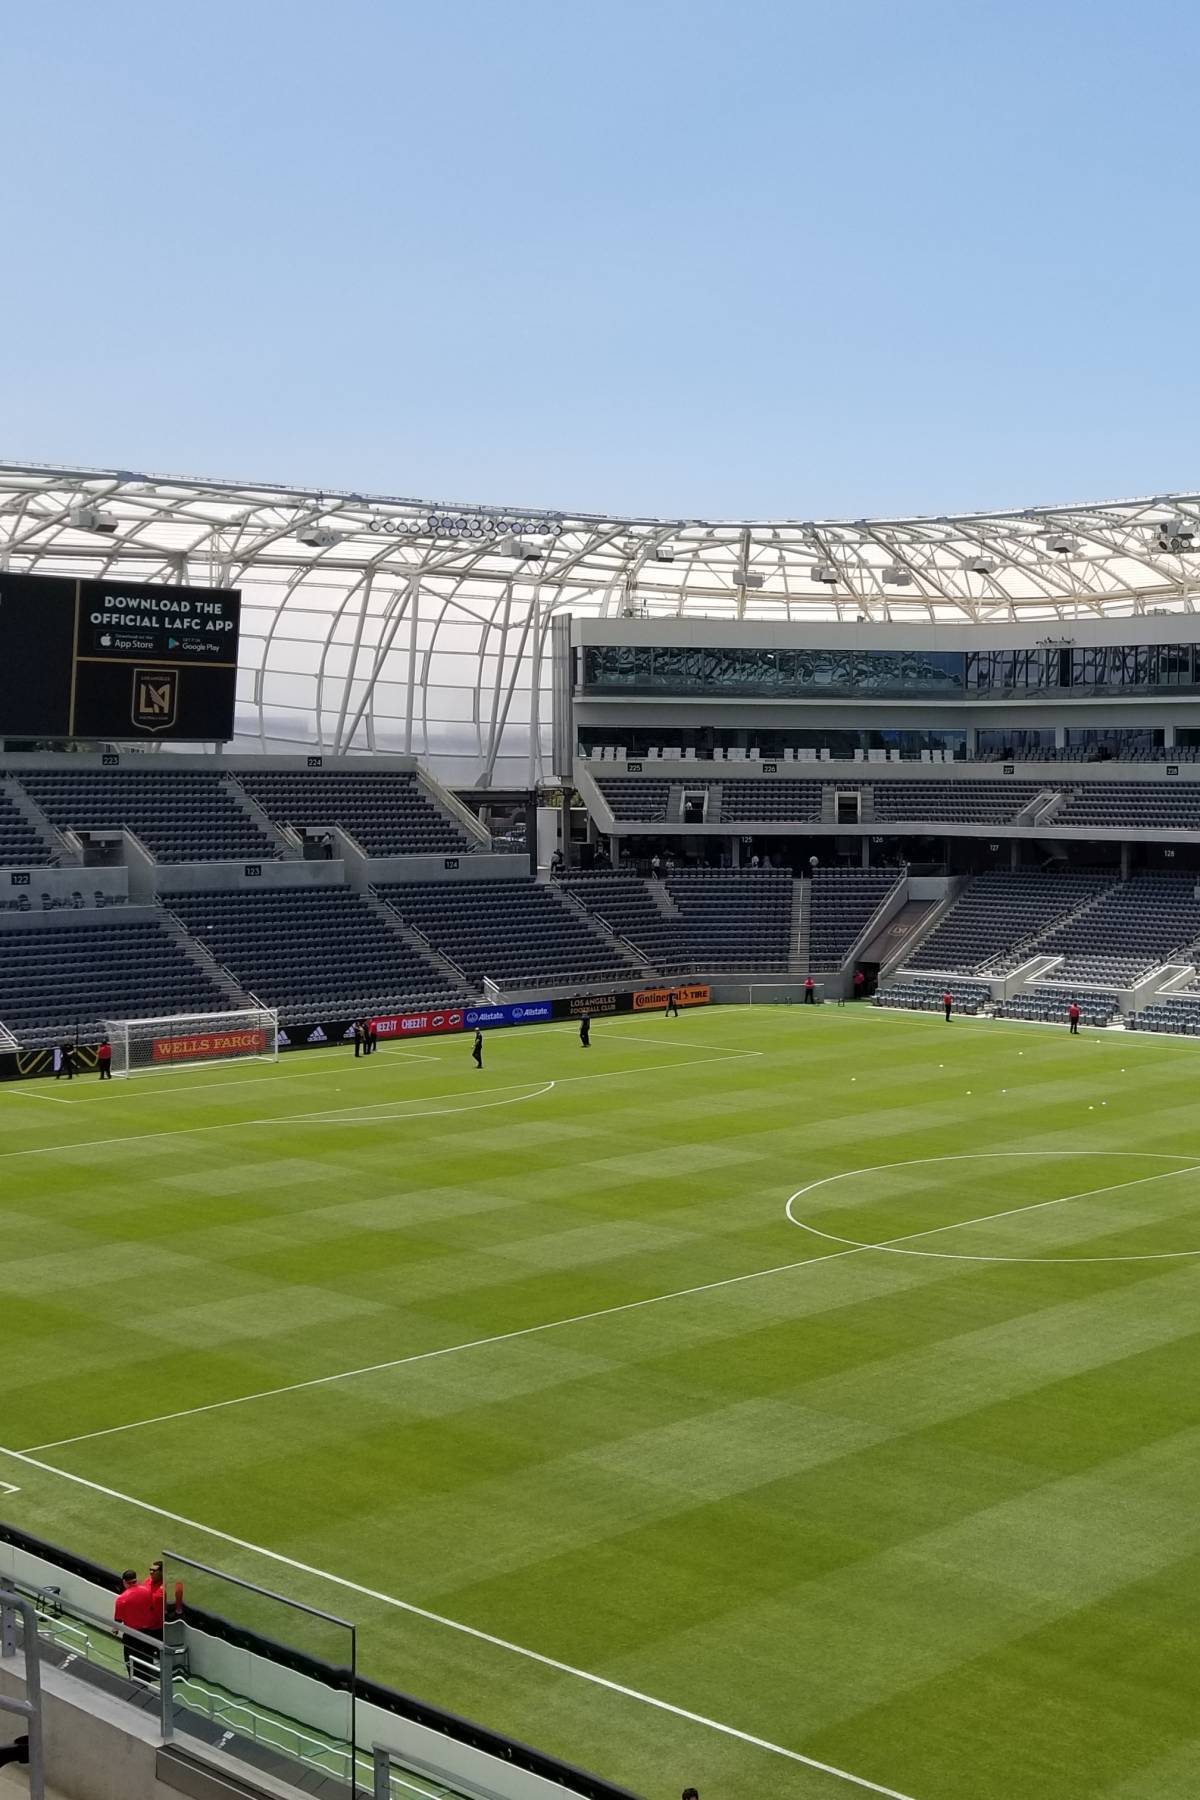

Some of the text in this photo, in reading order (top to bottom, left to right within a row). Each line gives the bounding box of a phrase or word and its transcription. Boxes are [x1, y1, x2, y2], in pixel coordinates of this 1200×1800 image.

[104, 596, 223, 615] DOWNLOAD THE
[90, 612, 234, 632] OFFICIAL LAFC APP
[114, 639, 154, 649] App Store
[182, 642, 220, 652] Google Play
[103, 756, 119, 765] 223
[309, 757, 322, 766] 224
[247, 867, 260, 875] 123
[13, 875, 29, 884] 122
[691, 990, 709, 999] TIRE
[570, 996, 616, 1008] LOS ANGELES
[601, 1004, 616, 1012] CLUB
[401, 1017, 428, 1030] CHEEZ-IT
[158, 1039, 210, 1055] WELLS
